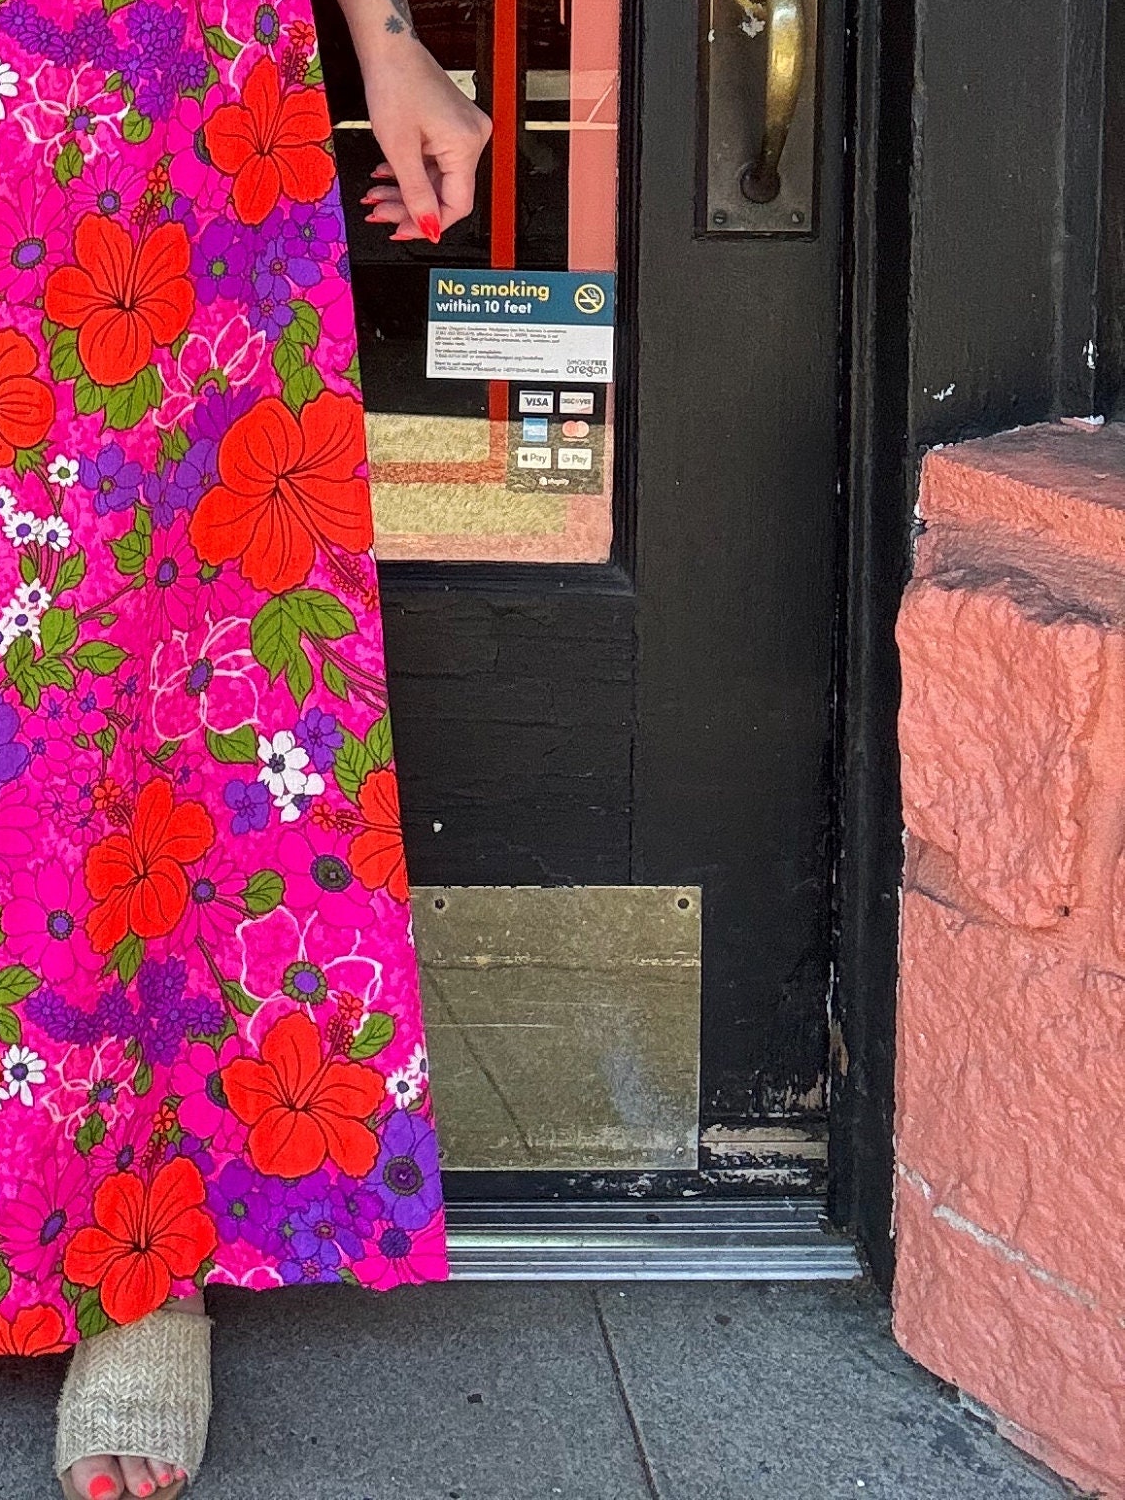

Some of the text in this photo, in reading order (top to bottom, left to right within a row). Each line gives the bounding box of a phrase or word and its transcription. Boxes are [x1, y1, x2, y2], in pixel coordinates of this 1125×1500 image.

[437, 279, 550, 302] No smoking
[436, 299, 532, 315] within 10 feet
[566, 365, 607, 377] oregon
[524, 397, 549, 406] VISA
[530, 453, 547, 465] Pay
[572, 454, 589, 466] Pay
